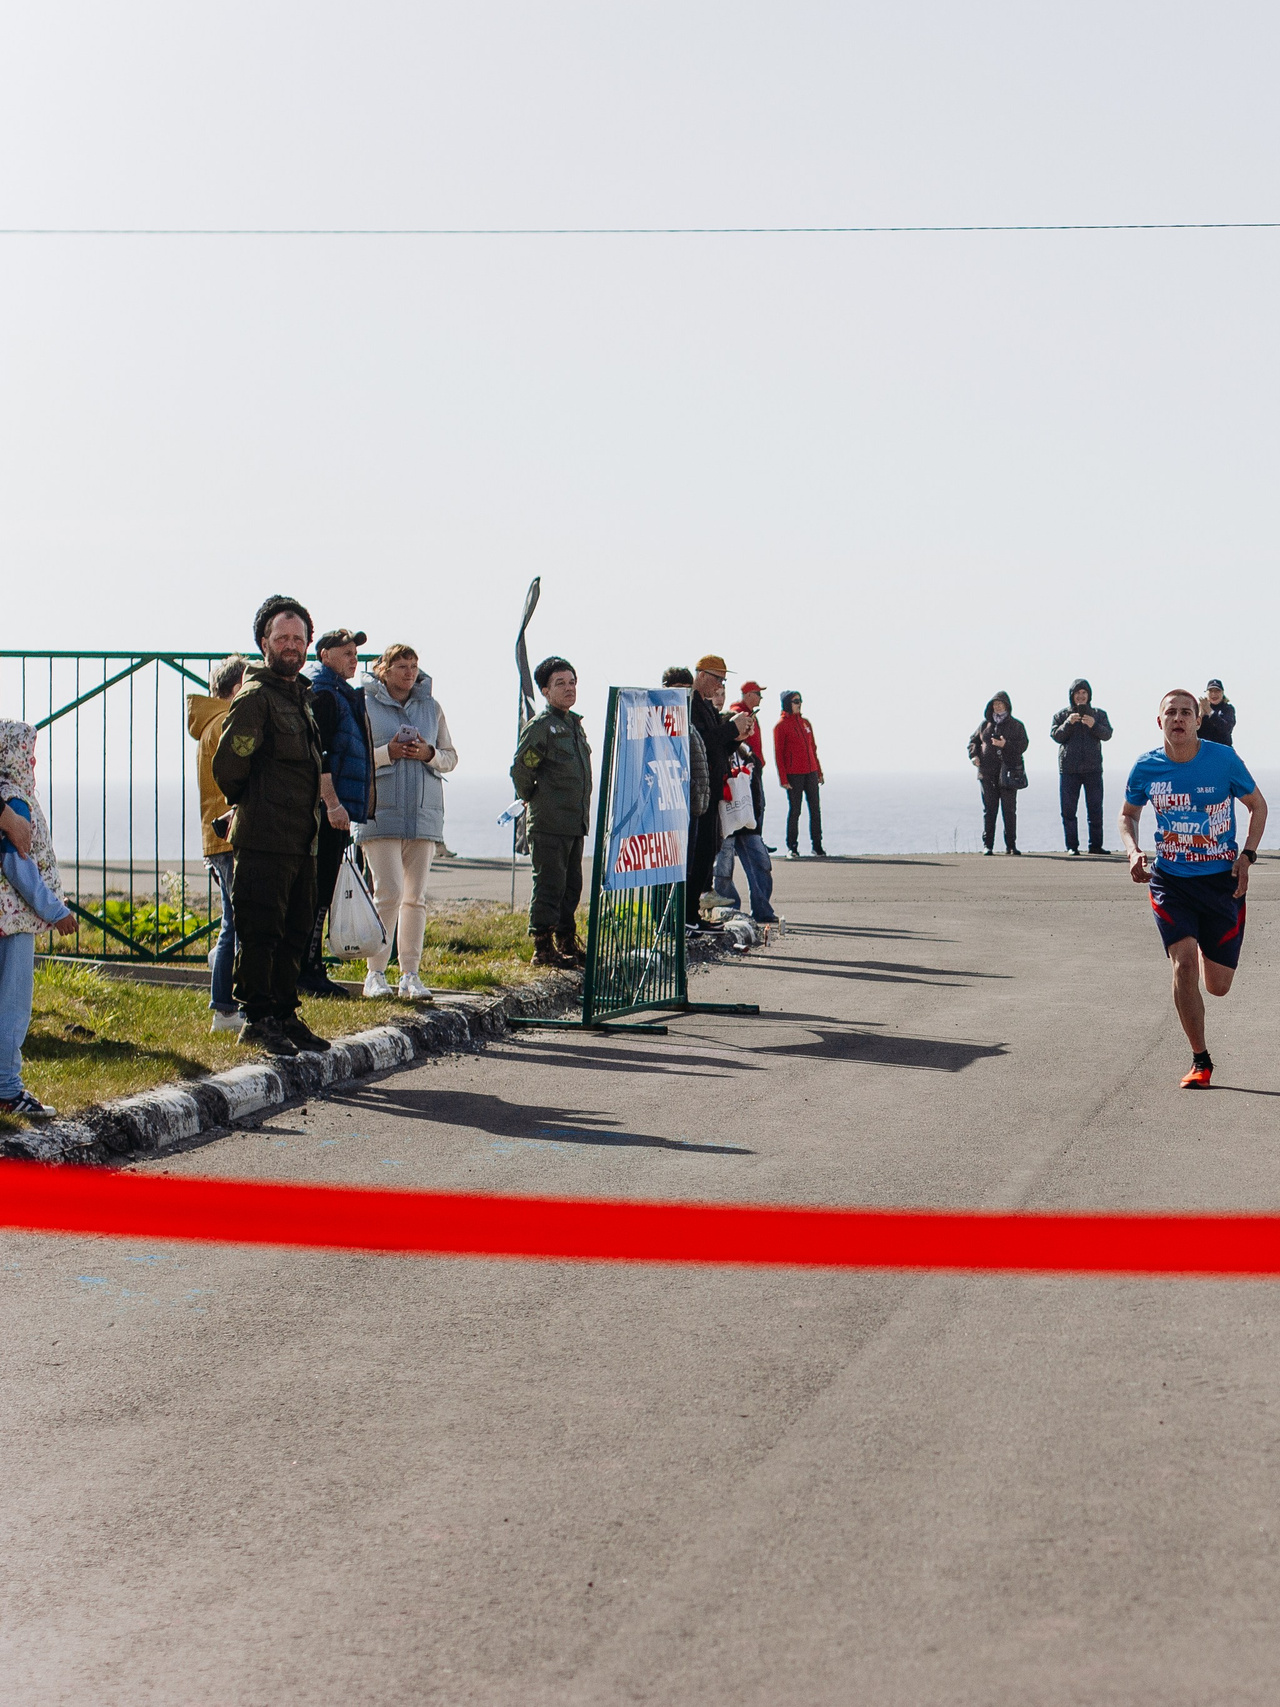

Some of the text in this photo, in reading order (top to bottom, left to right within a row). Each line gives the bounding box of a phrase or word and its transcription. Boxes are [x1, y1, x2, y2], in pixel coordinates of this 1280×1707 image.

[1149, 781, 1173, 795] 2024
[1153, 793, 1191, 808] #МЕЧТА
[1171, 820, 1201, 834] 20072
